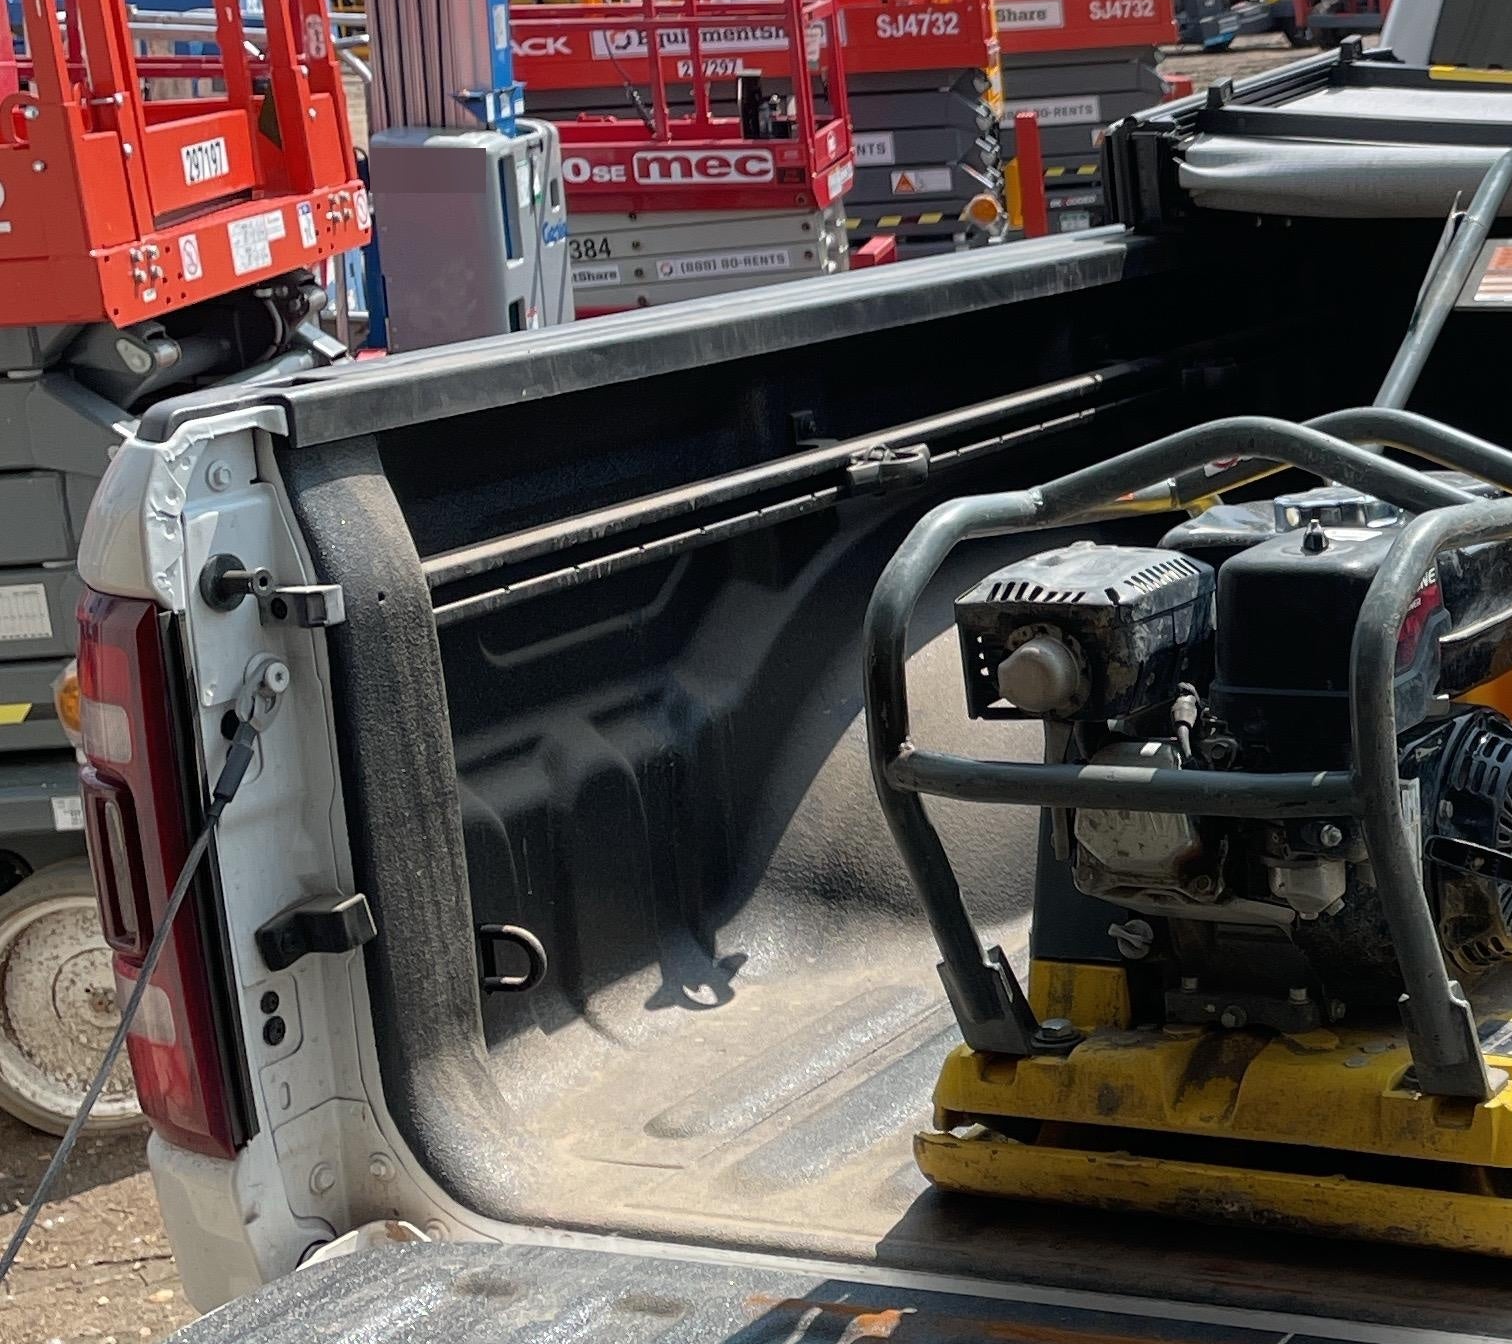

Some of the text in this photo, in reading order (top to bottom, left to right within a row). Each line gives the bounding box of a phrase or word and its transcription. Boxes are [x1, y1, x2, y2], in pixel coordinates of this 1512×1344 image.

[876, 9, 960, 39] SJ4732
[185, 141, 223, 182] 297197
[636, 155, 771, 179] mec
